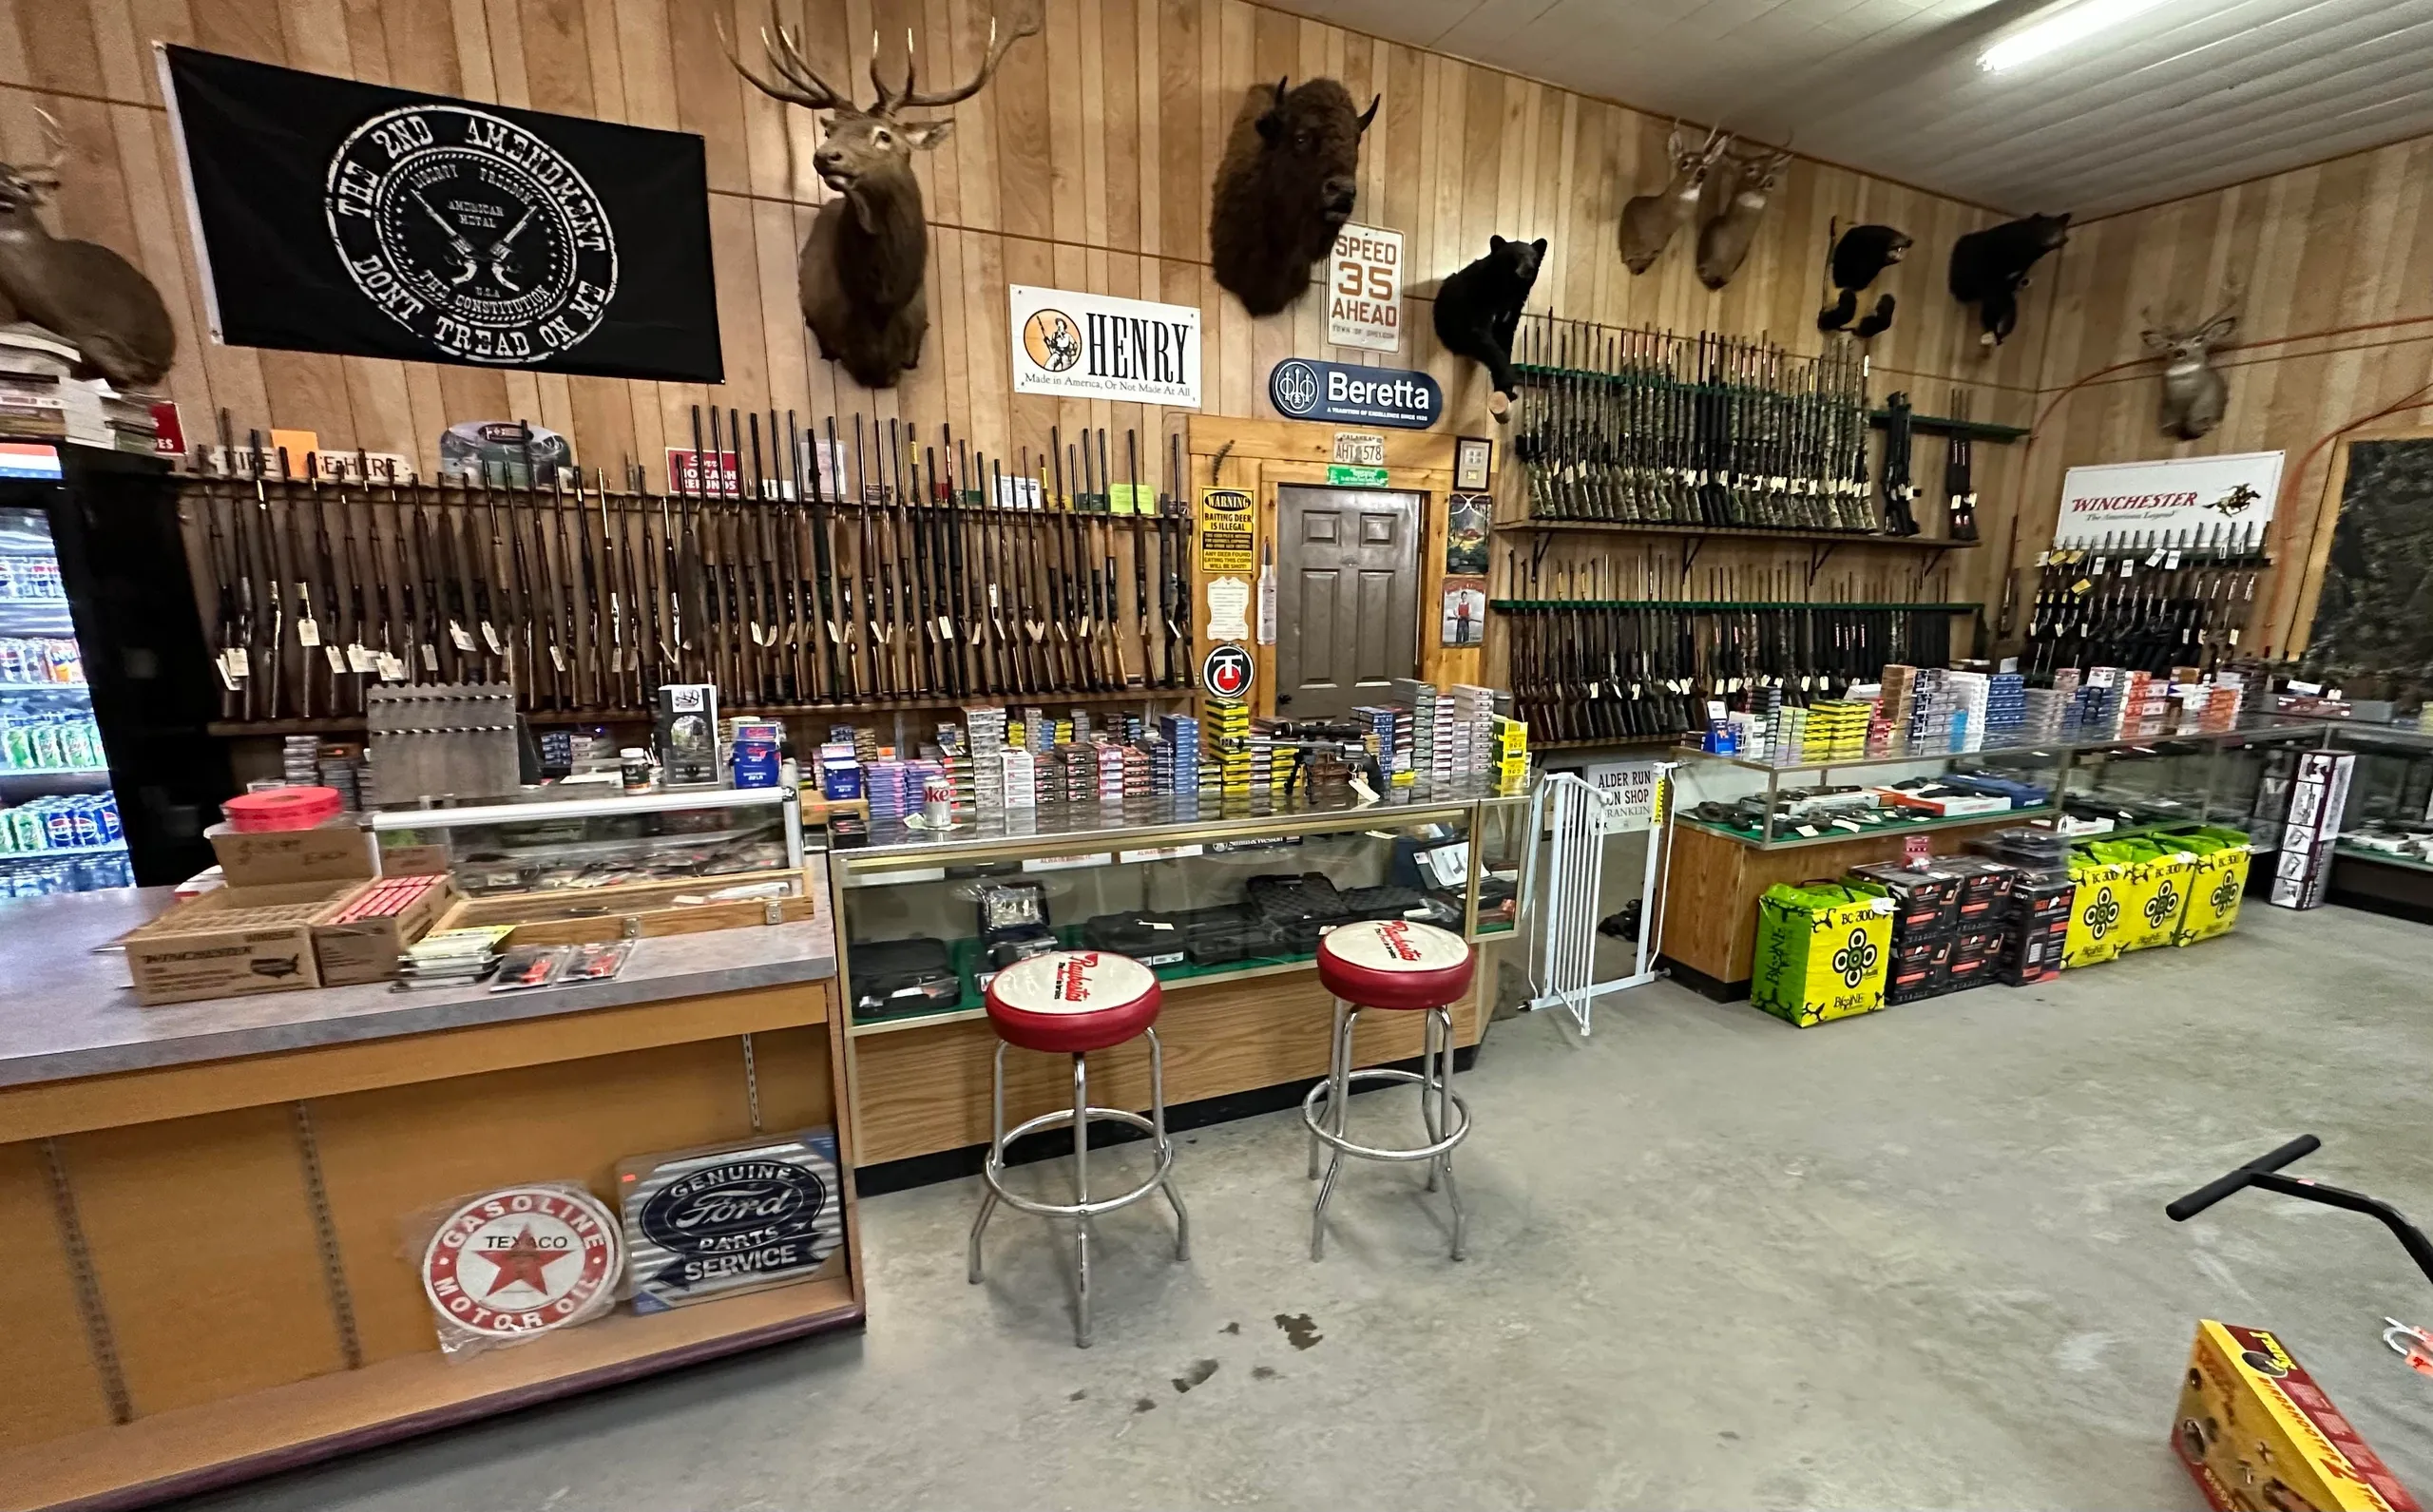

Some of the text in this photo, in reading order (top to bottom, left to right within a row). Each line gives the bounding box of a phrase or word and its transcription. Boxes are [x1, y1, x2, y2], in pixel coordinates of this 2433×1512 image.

[338, 116, 606, 252] THE 2ND AMENDMENT
[410, 164, 534, 204] LIBERTY FREEDOM
[448, 200, 505, 217] AMERICAN
[459, 214, 497, 228] METAL
[1335, 235, 1396, 265] SPEED
[419, 269, 551, 315] THE CONSTITUTION
[1338, 261, 1393, 301] 35
[354, 255, 606, 356] DONT TREAD ON ME
[1331, 297, 1397, 327] AHEAD
[1086, 313, 1189, 385] HENRY
[1025, 373, 1191, 397] Made in America, Or Not Made At All
[1329, 371, 1429, 410] Beretta
[1336, 444, 1382, 461] AHT 578
[1207, 495, 1249, 508] WARNING
[2072, 492, 2198, 512] WINCHESTER
[1204, 513, 1233, 522] BAITING
[1219, 523, 1245, 531] ILLEGAL
[1599, 771, 1651, 789] ALDER RUN
[1604, 806, 1650, 817] RANKLIN
[1624, 789, 1649, 804] SHOP
[1841, 909, 1874, 925] BC 300
[671, 1165, 792, 1198] GENUINE
[443, 1196, 604, 1250] GASOLINE
[676, 1188, 792, 1228] Ford
[487, 1235, 568, 1249] TEXACO
[699, 1226, 779, 1251] PARTS
[684, 1244, 797, 1281] SERVICE
[434, 1276, 600, 1330] MOTOR OIL
[2257, 1377, 2342, 1463] BIRDSHOOTER
